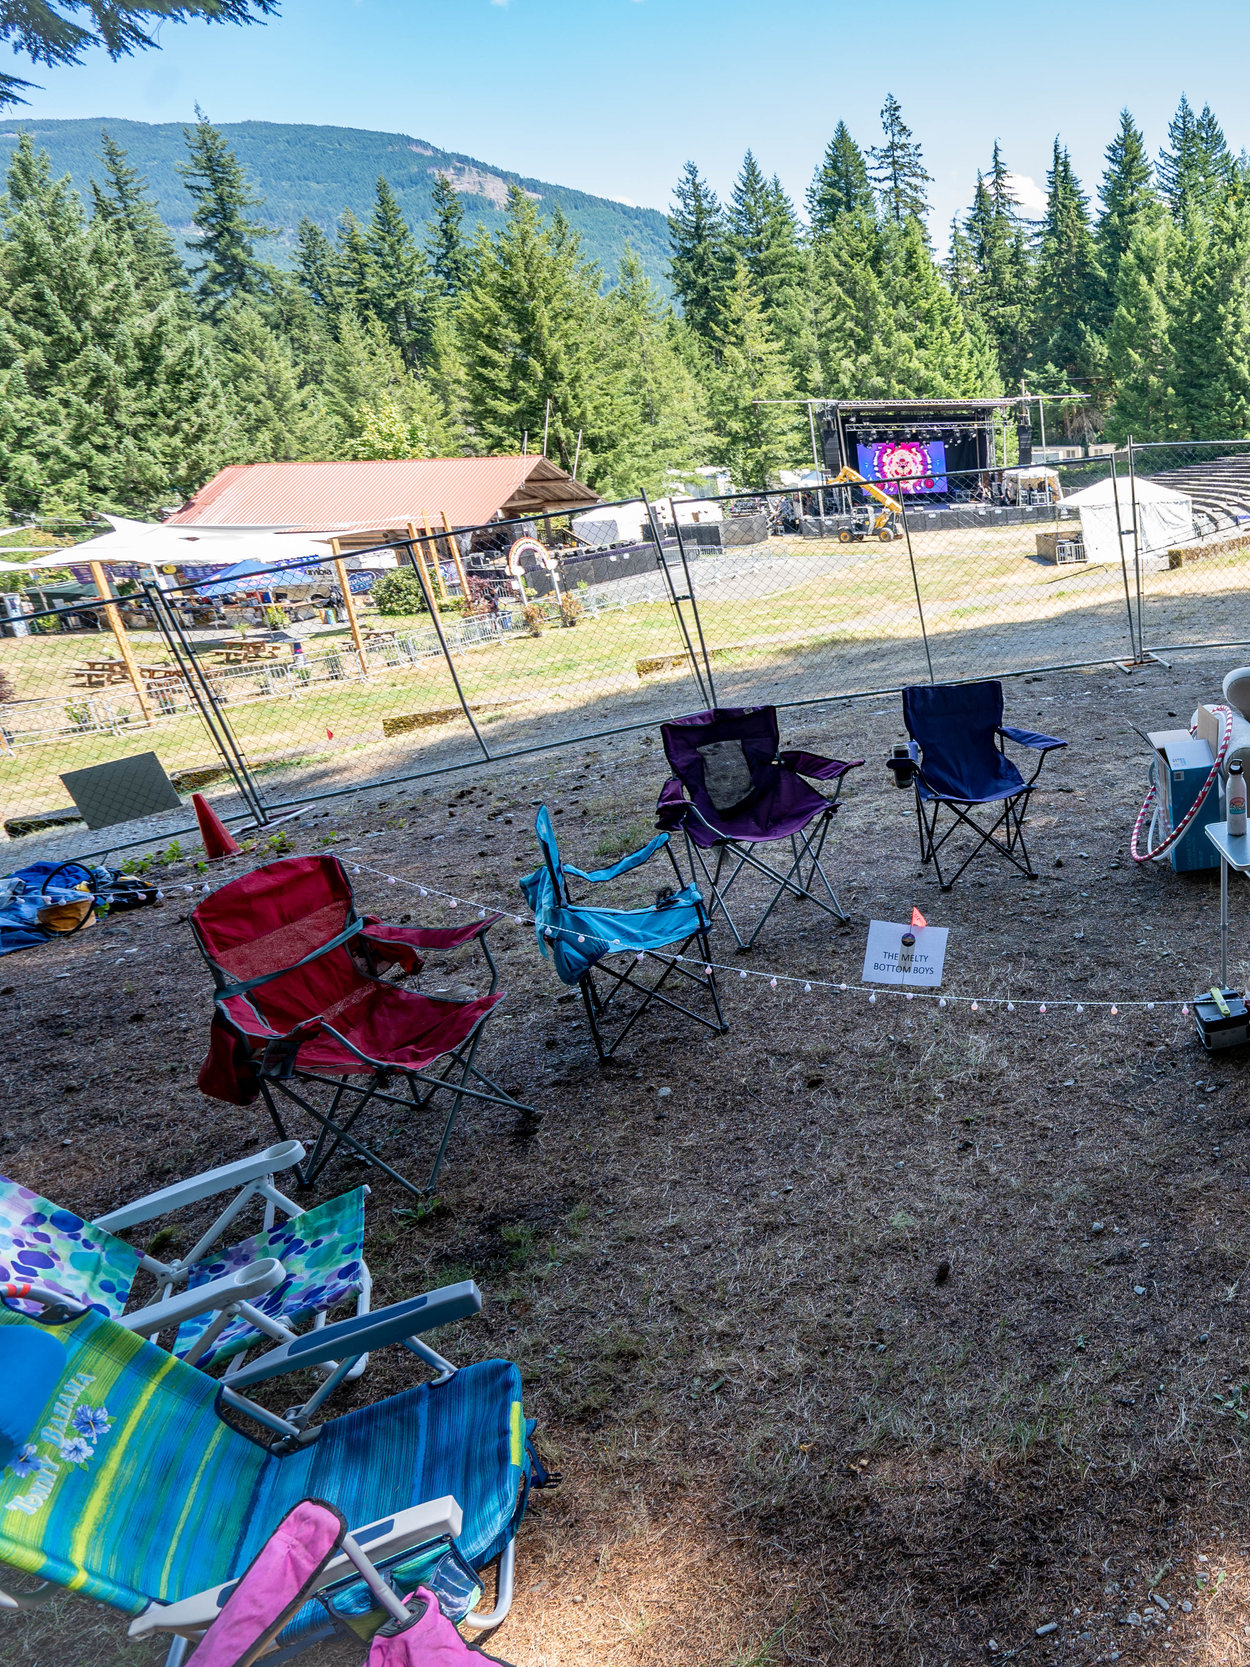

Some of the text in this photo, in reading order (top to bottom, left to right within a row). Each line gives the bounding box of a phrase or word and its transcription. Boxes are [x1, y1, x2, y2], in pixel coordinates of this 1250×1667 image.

[883, 951, 929, 963] THE MELTY
[873, 962, 935, 975] BOTTOM BOYS
